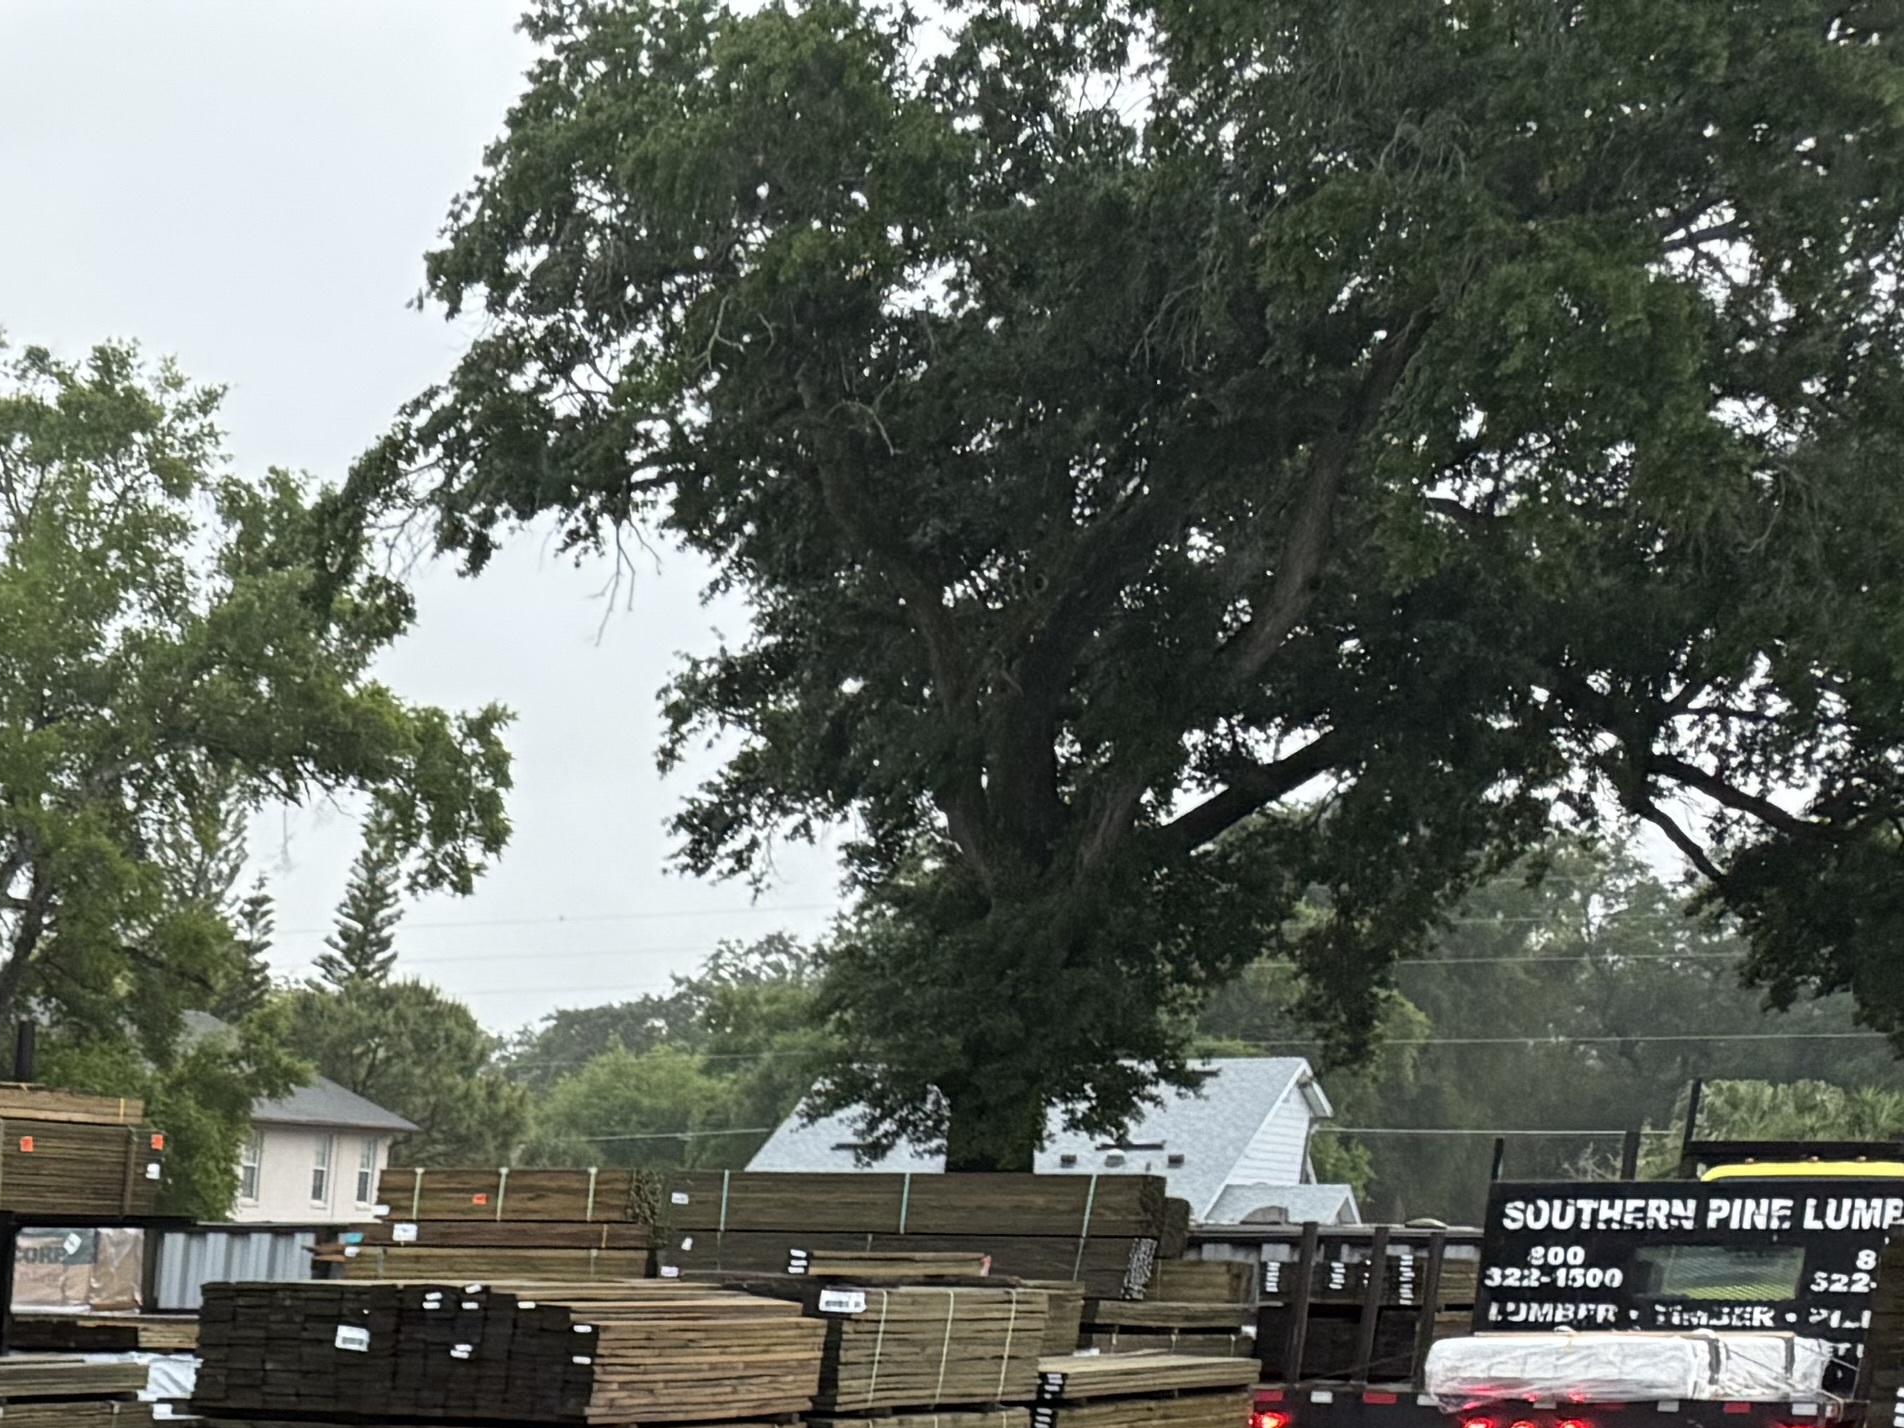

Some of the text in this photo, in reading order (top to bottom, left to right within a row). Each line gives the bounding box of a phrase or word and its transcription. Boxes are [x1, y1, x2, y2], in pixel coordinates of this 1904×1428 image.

[1502, 1198, 1697, 1230] SOUTHERN
[1706, 1198, 1794, 1230] PINE
[1528, 1246, 1585, 1265] 800
[1484, 1267, 1623, 1288] 322-1500
[1488, 1302, 1618, 1323] LUMBER
